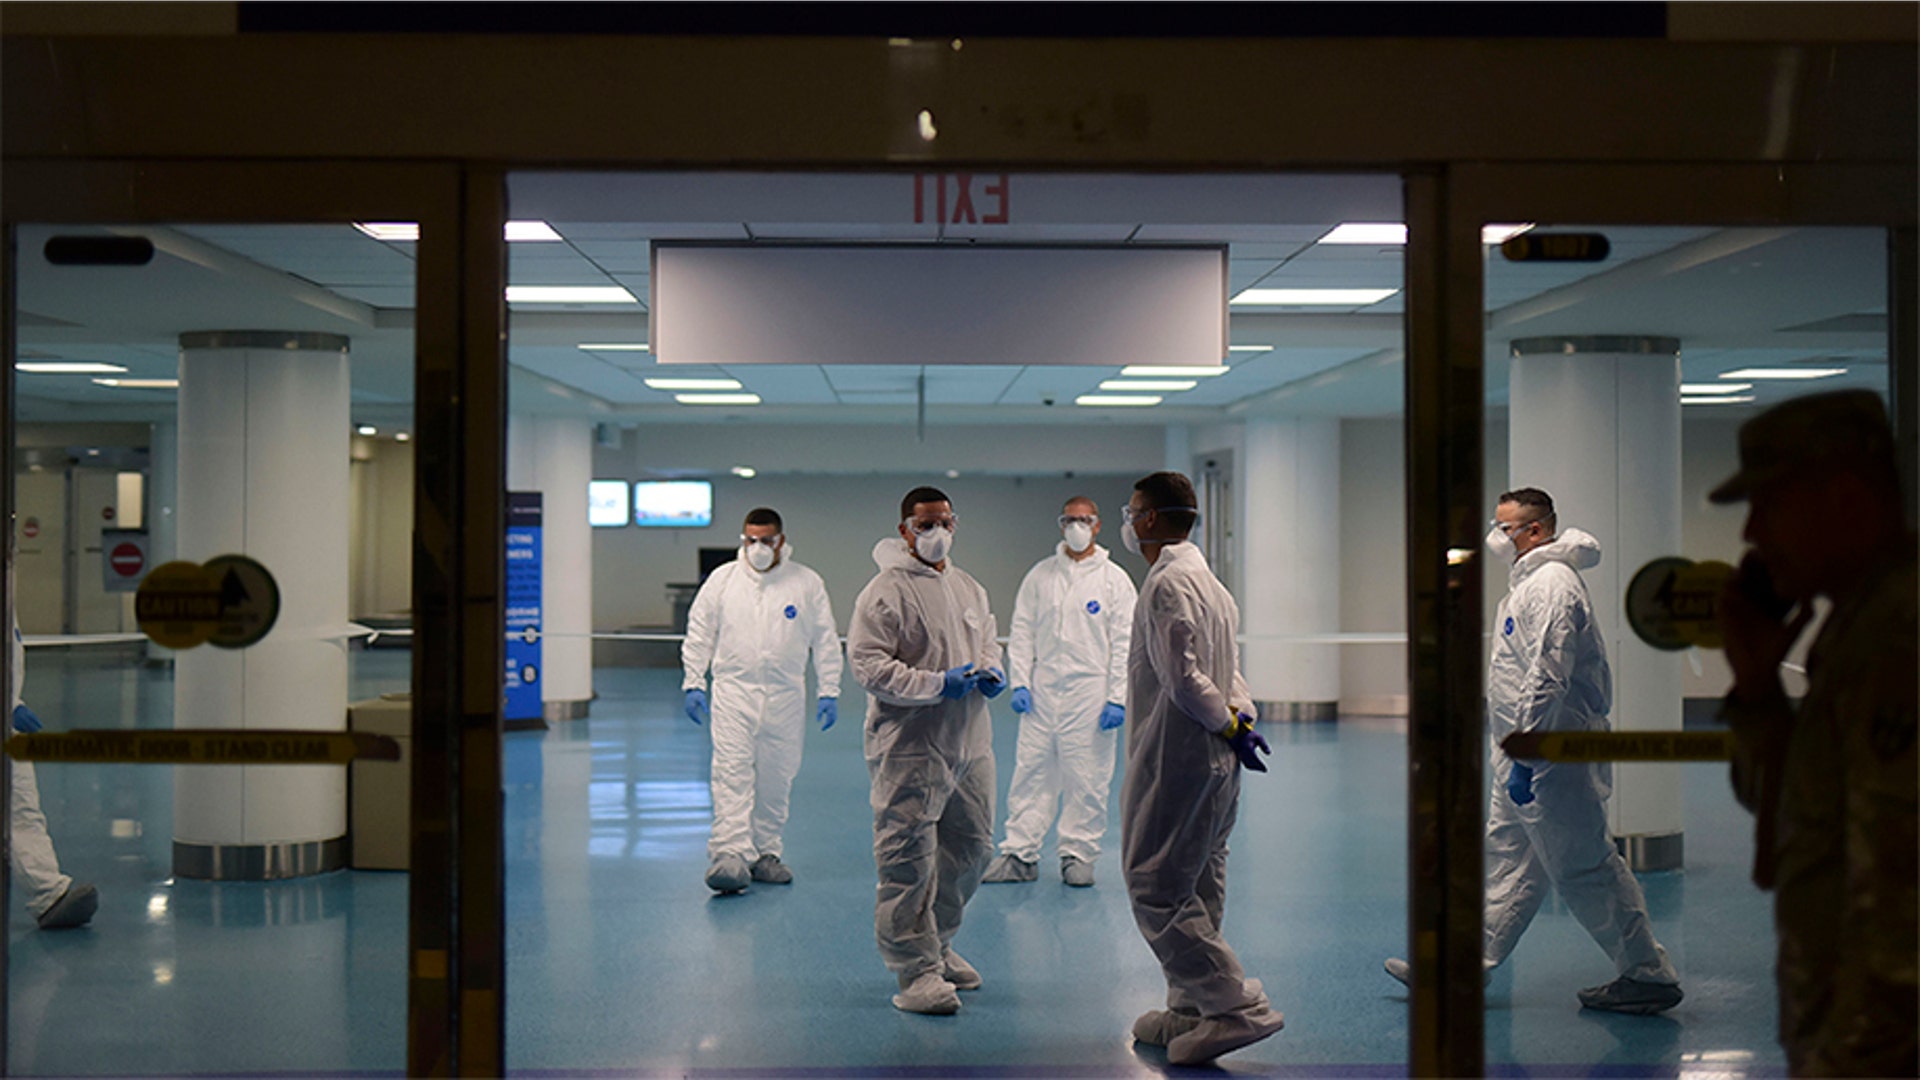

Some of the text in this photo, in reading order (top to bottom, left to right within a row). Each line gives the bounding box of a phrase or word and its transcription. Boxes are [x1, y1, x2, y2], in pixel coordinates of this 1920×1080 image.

[140, 595, 219, 614] CAUTION
[26, 738, 133, 757] AUTOMATIC
[139, 739, 191, 758] DOOR
[204, 740, 267, 758] STAND
[270, 740, 329, 758] CLEAR
[1562, 738, 1724, 757] AUTOMATIC DOOR
